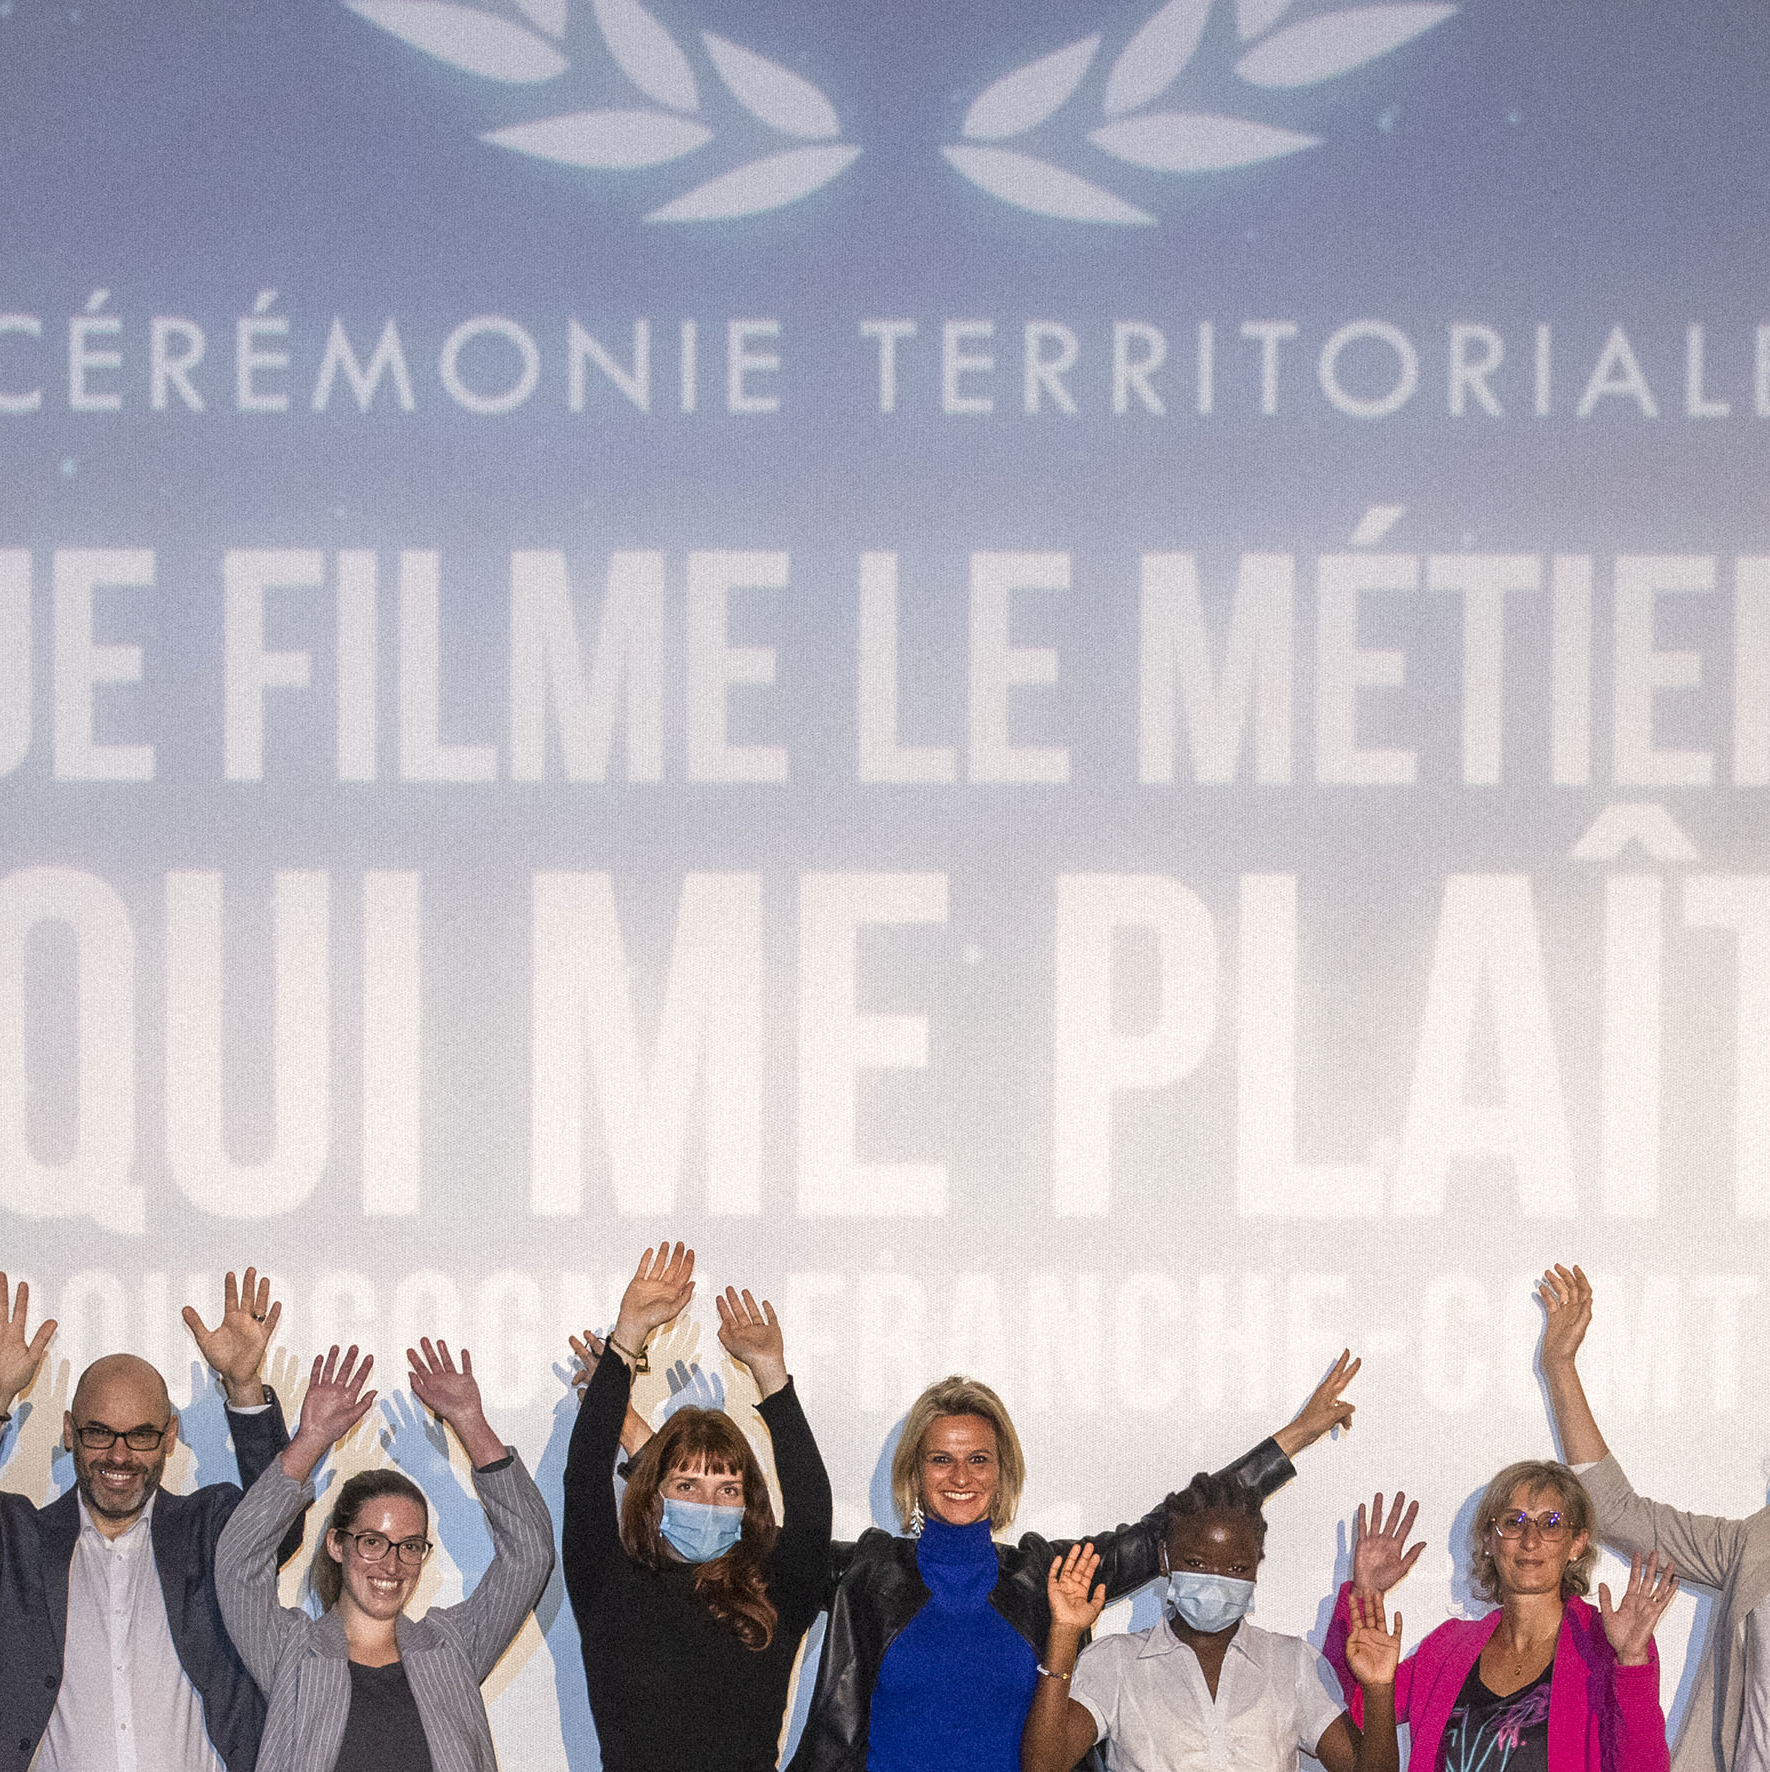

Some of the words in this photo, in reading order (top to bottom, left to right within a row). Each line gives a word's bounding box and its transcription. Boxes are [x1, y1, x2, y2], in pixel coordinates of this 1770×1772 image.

[224, 550, 790, 786] FILME
[857, 553, 1071, 787] LE
[530, 868, 951, 1221] ME
